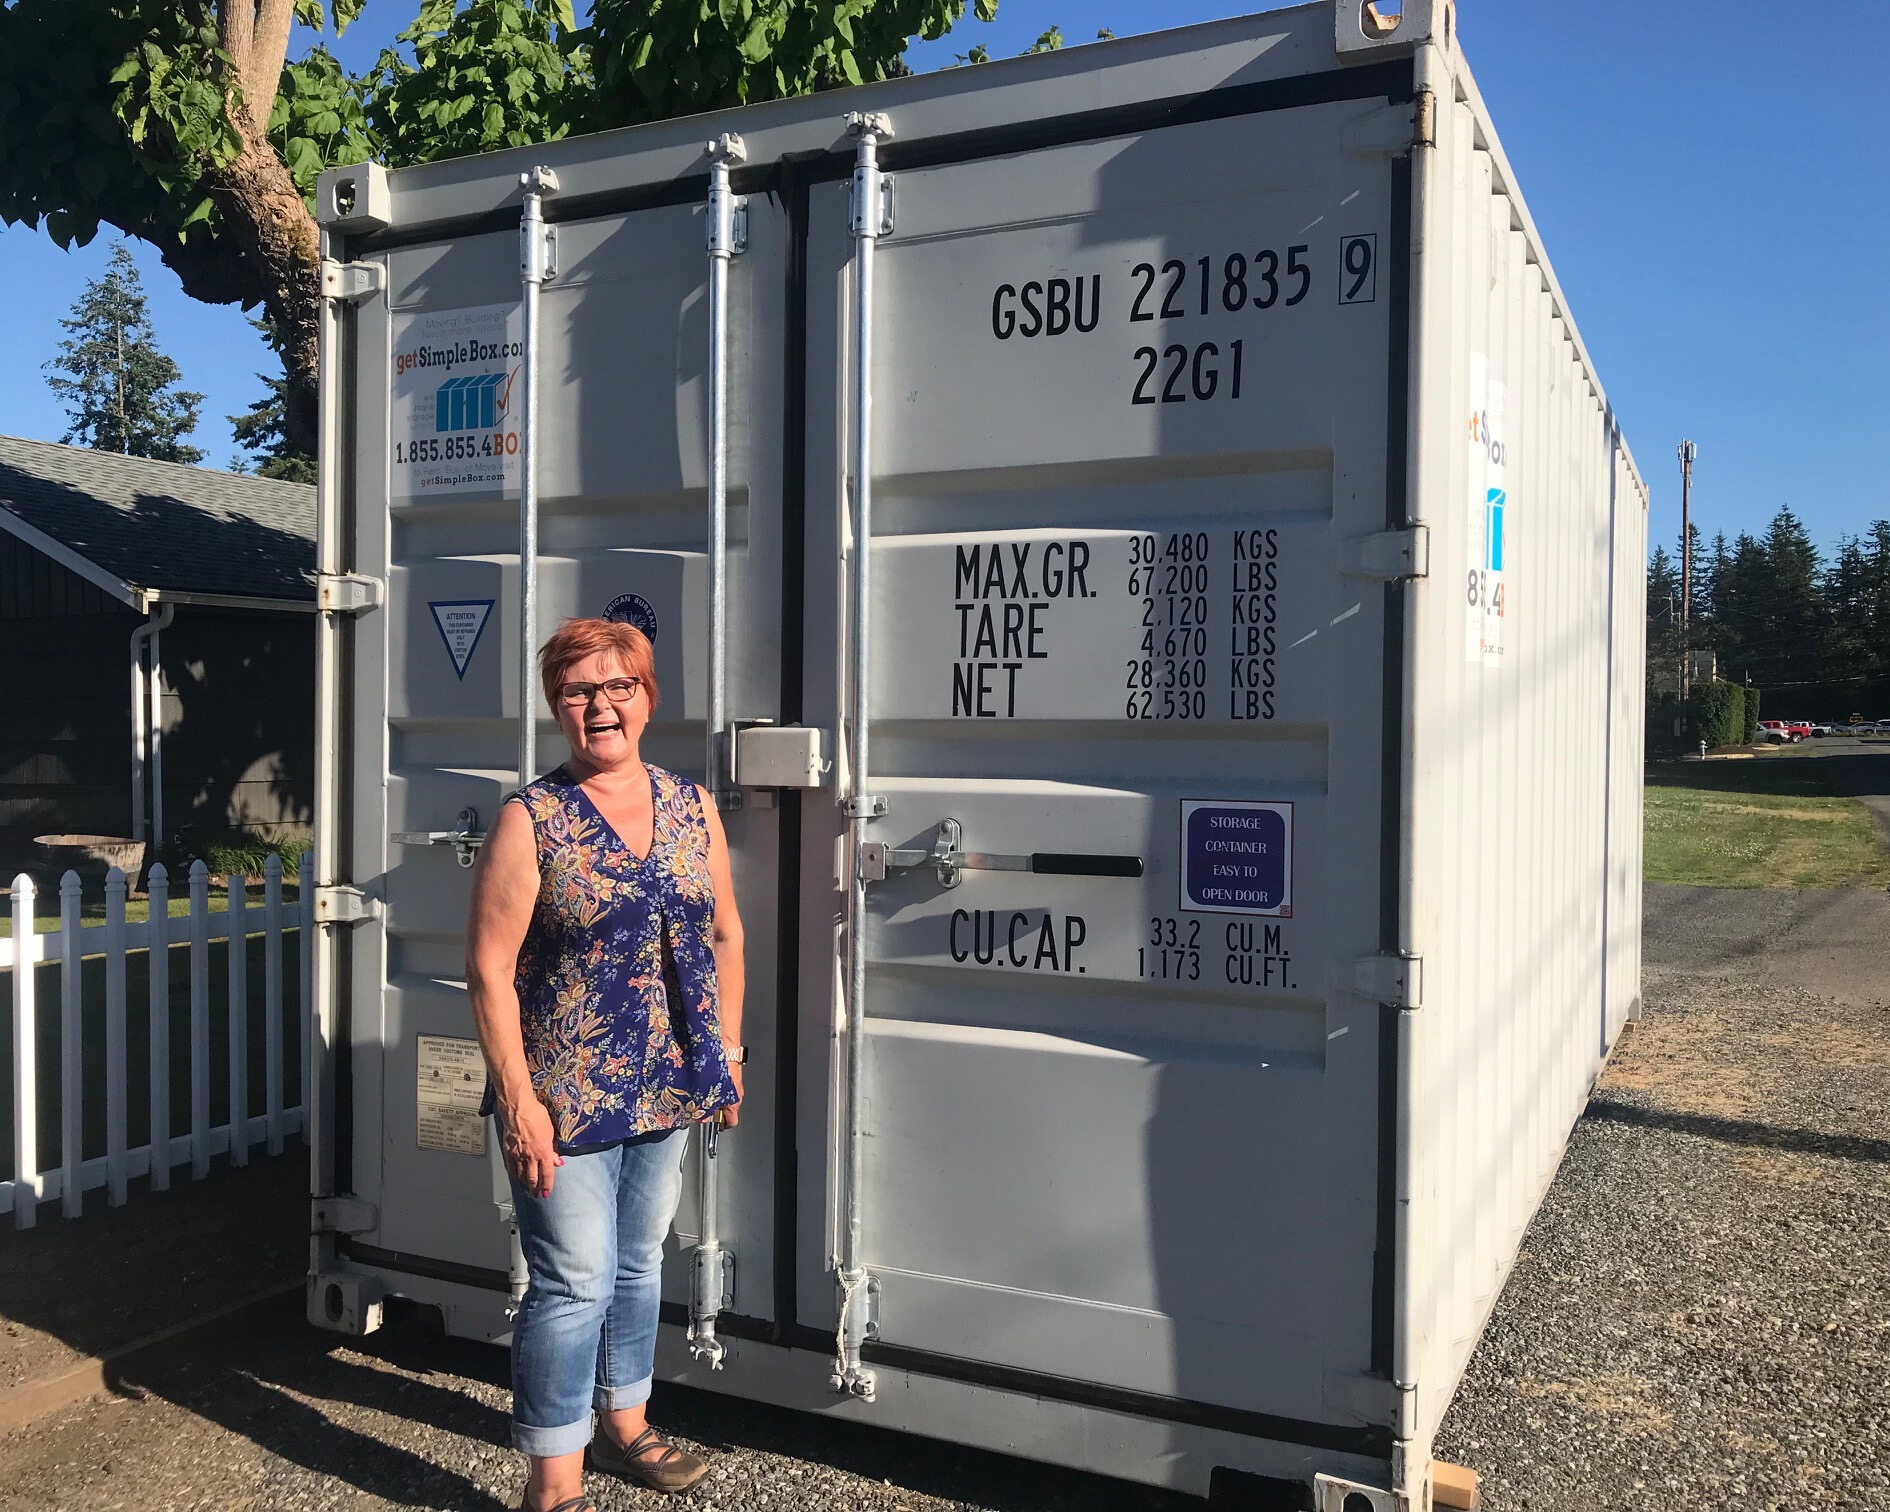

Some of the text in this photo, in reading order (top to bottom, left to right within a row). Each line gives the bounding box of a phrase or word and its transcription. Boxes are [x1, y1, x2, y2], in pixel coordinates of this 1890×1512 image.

[992, 239, 1371, 340] GSBU 221835 9
[425, 310, 505, 328] Moving? Building?
[397, 340, 522, 375] getSimpleBox.co
[1131, 339, 1243, 405] 22G1
[397, 432, 521, 463] 1.855.855.4BO
[421, 474, 505, 487] getSimpleBox.com
[1233, 529, 1278, 560] KGS
[955, 541, 1097, 599] MAX.GR.
[1232, 562, 1278, 593] LBS
[446, 612, 476, 620] ATTENTION
[634, 597, 656, 628] BUREAU
[1231, 594, 1277, 625] KGS
[955, 603, 1050, 659] TARE
[1231, 626, 1276, 657] LBS
[1231, 658, 1276, 689] KGS
[952, 662, 1023, 718] NET
[1230, 690, 1275, 720] LBS
[1210, 816, 1261, 830] STORAGE
[1205, 840, 1267, 854] CONTAINER
[1213, 864, 1257, 878] EASY TO
[1202, 887, 1268, 902] OPEN DOOR
[949, 908, 1086, 974] CU.CAP.
[1150, 917, 1289, 955] 33.2 CU.M.
[1225, 954, 1297, 988] CU.FT.
